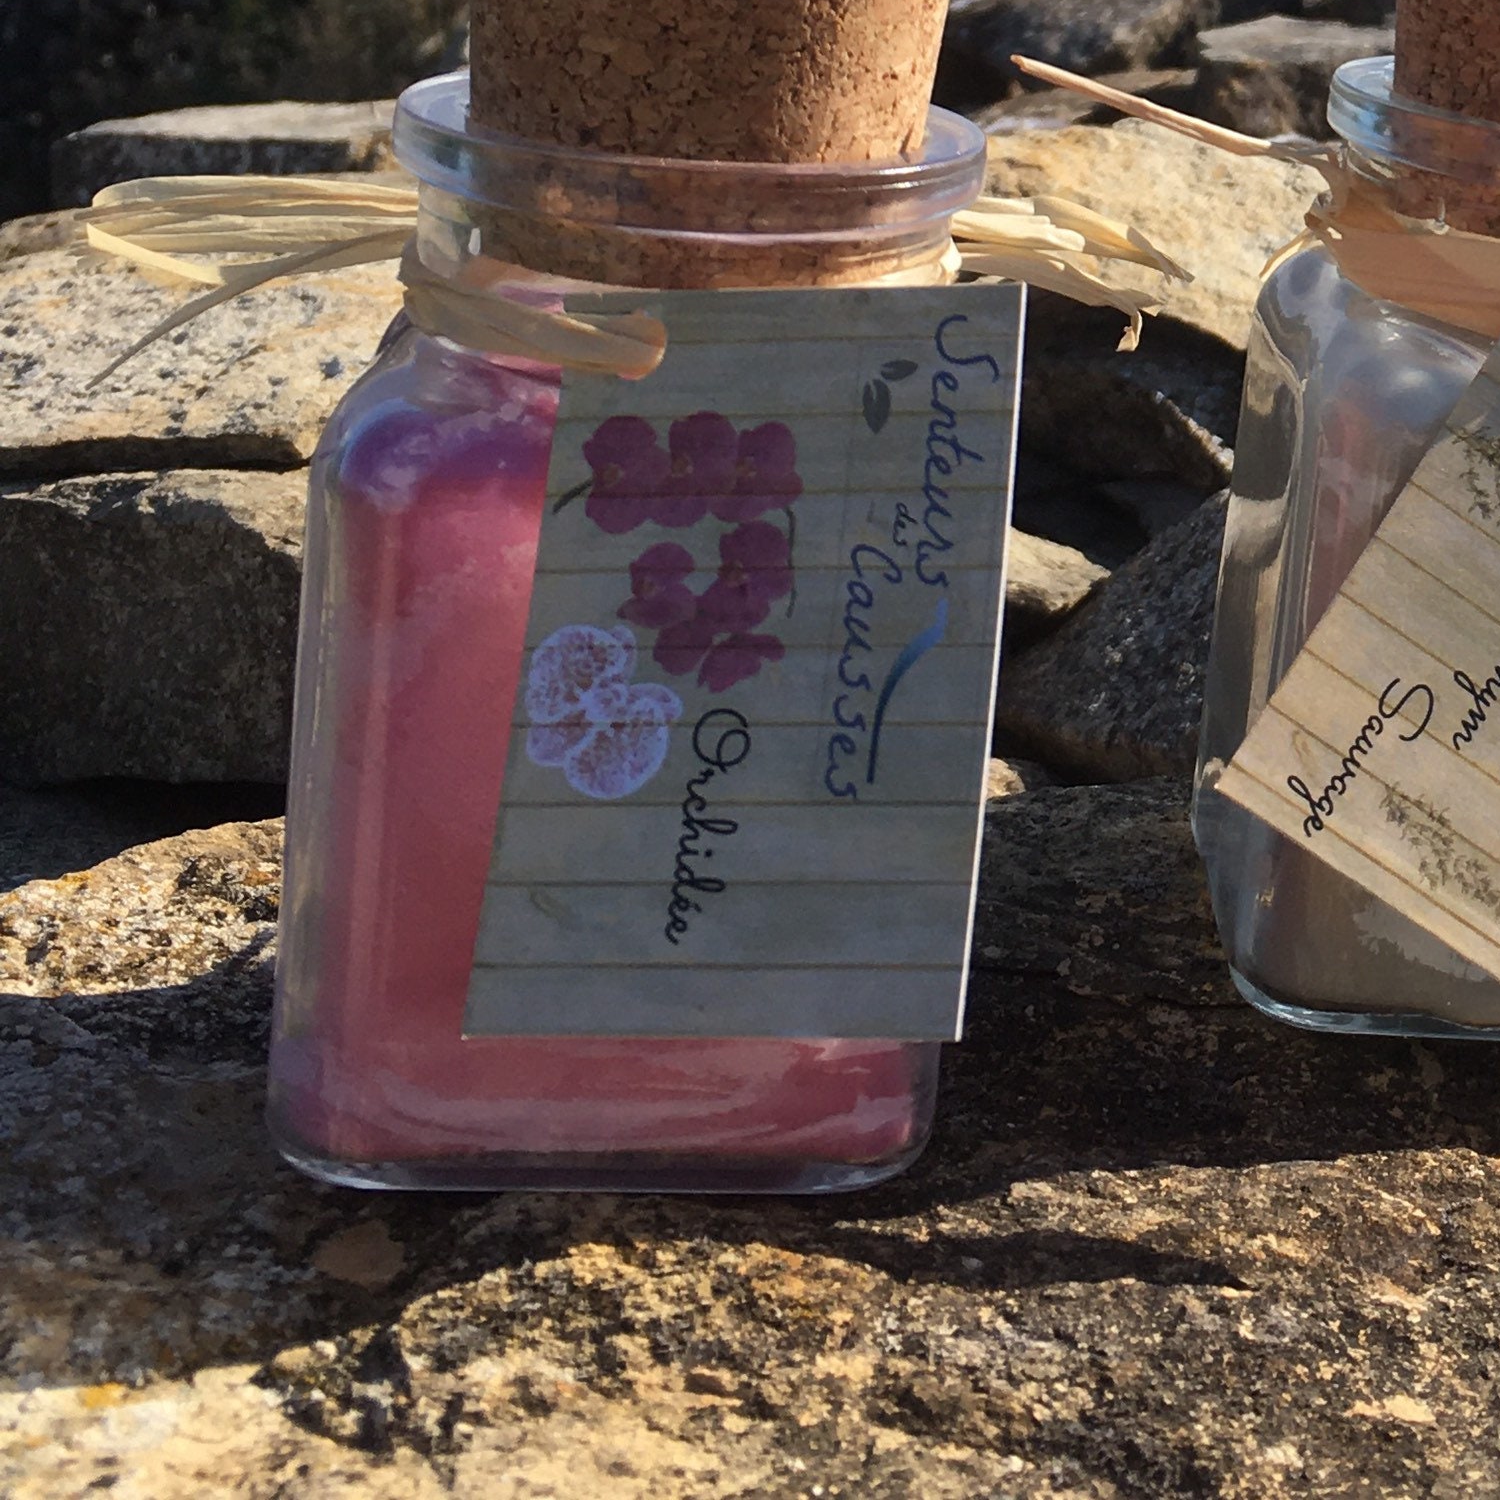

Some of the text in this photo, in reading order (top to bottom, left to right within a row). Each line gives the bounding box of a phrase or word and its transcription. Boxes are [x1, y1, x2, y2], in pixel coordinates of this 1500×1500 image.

[915, 314, 1000, 588] Senteurs
[825, 543, 900, 799] Causses
[1287, 677, 1435, 838] Sauvage
[665, 707, 752, 945] Orchidée
